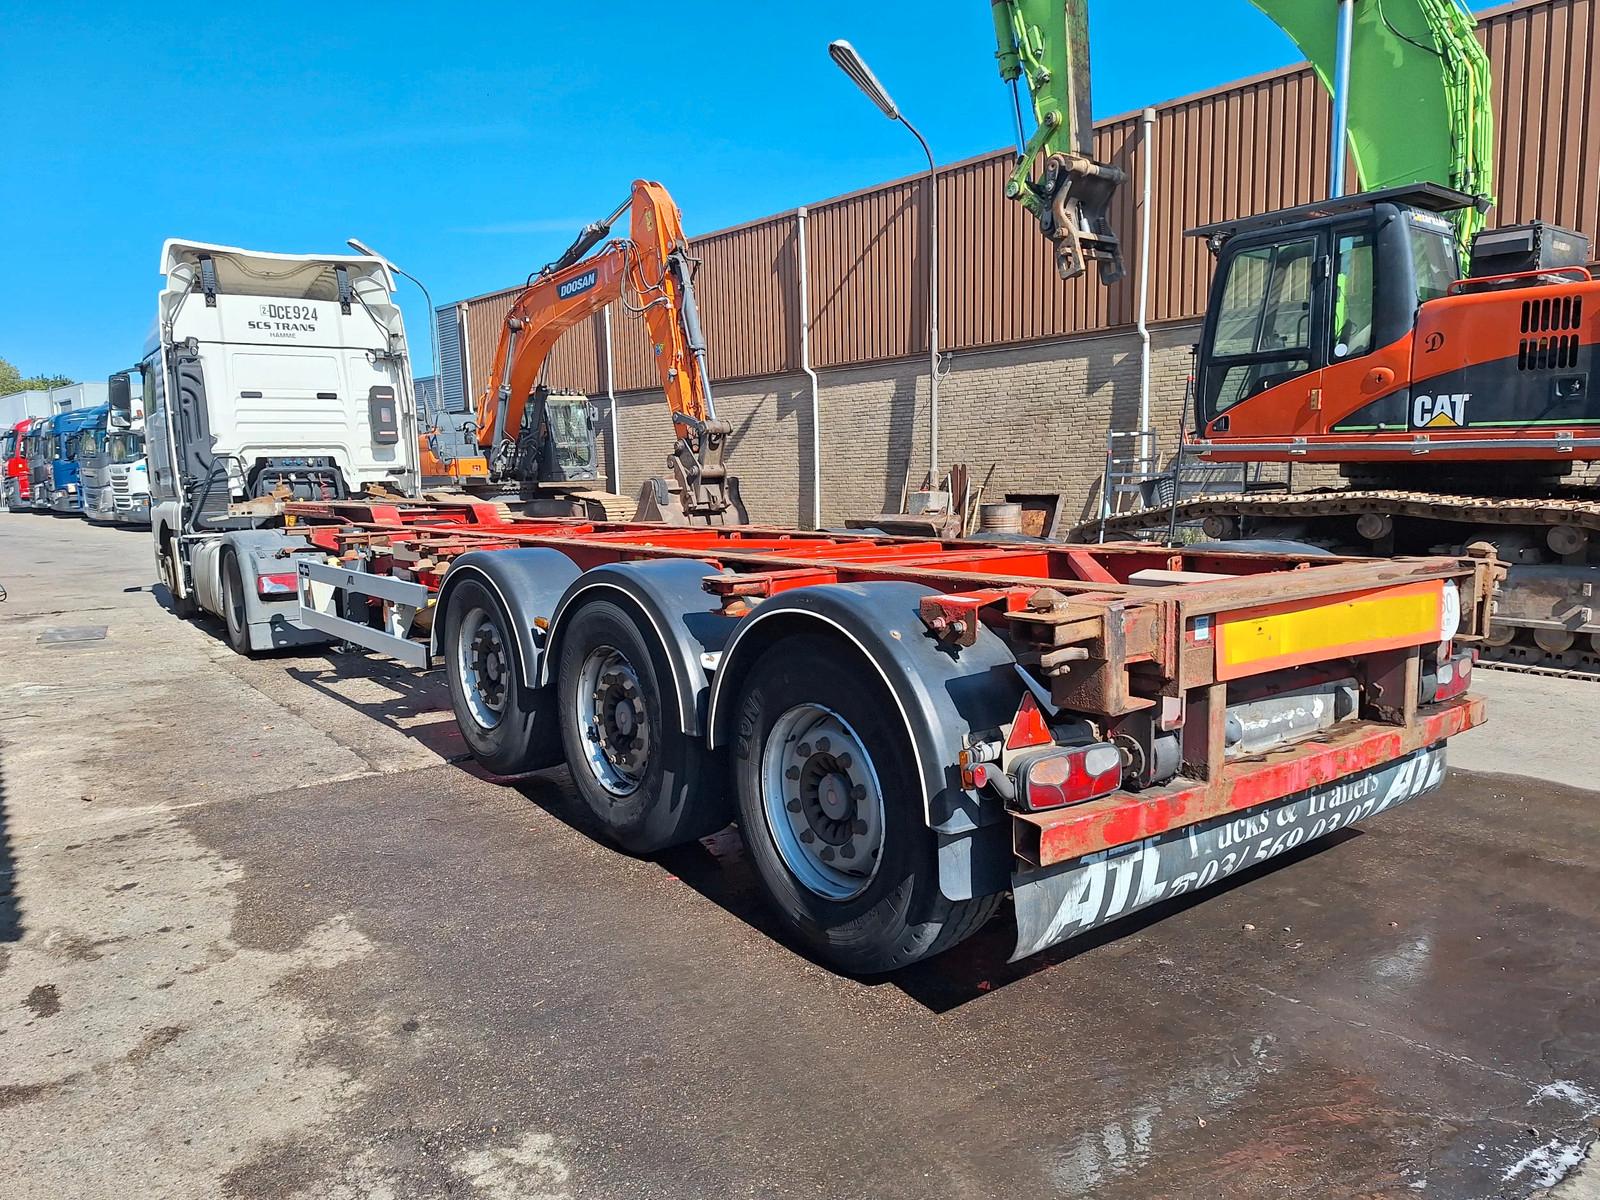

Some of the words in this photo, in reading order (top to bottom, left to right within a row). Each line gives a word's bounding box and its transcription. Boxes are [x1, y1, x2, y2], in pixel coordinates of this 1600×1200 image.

[560, 272, 595, 297] DOOSAN
[247, 320, 272, 330] SCS
[273, 321, 316, 332] TRANS
[1413, 393, 1470, 427] CAT
[1032, 836, 1168, 950] ATL
